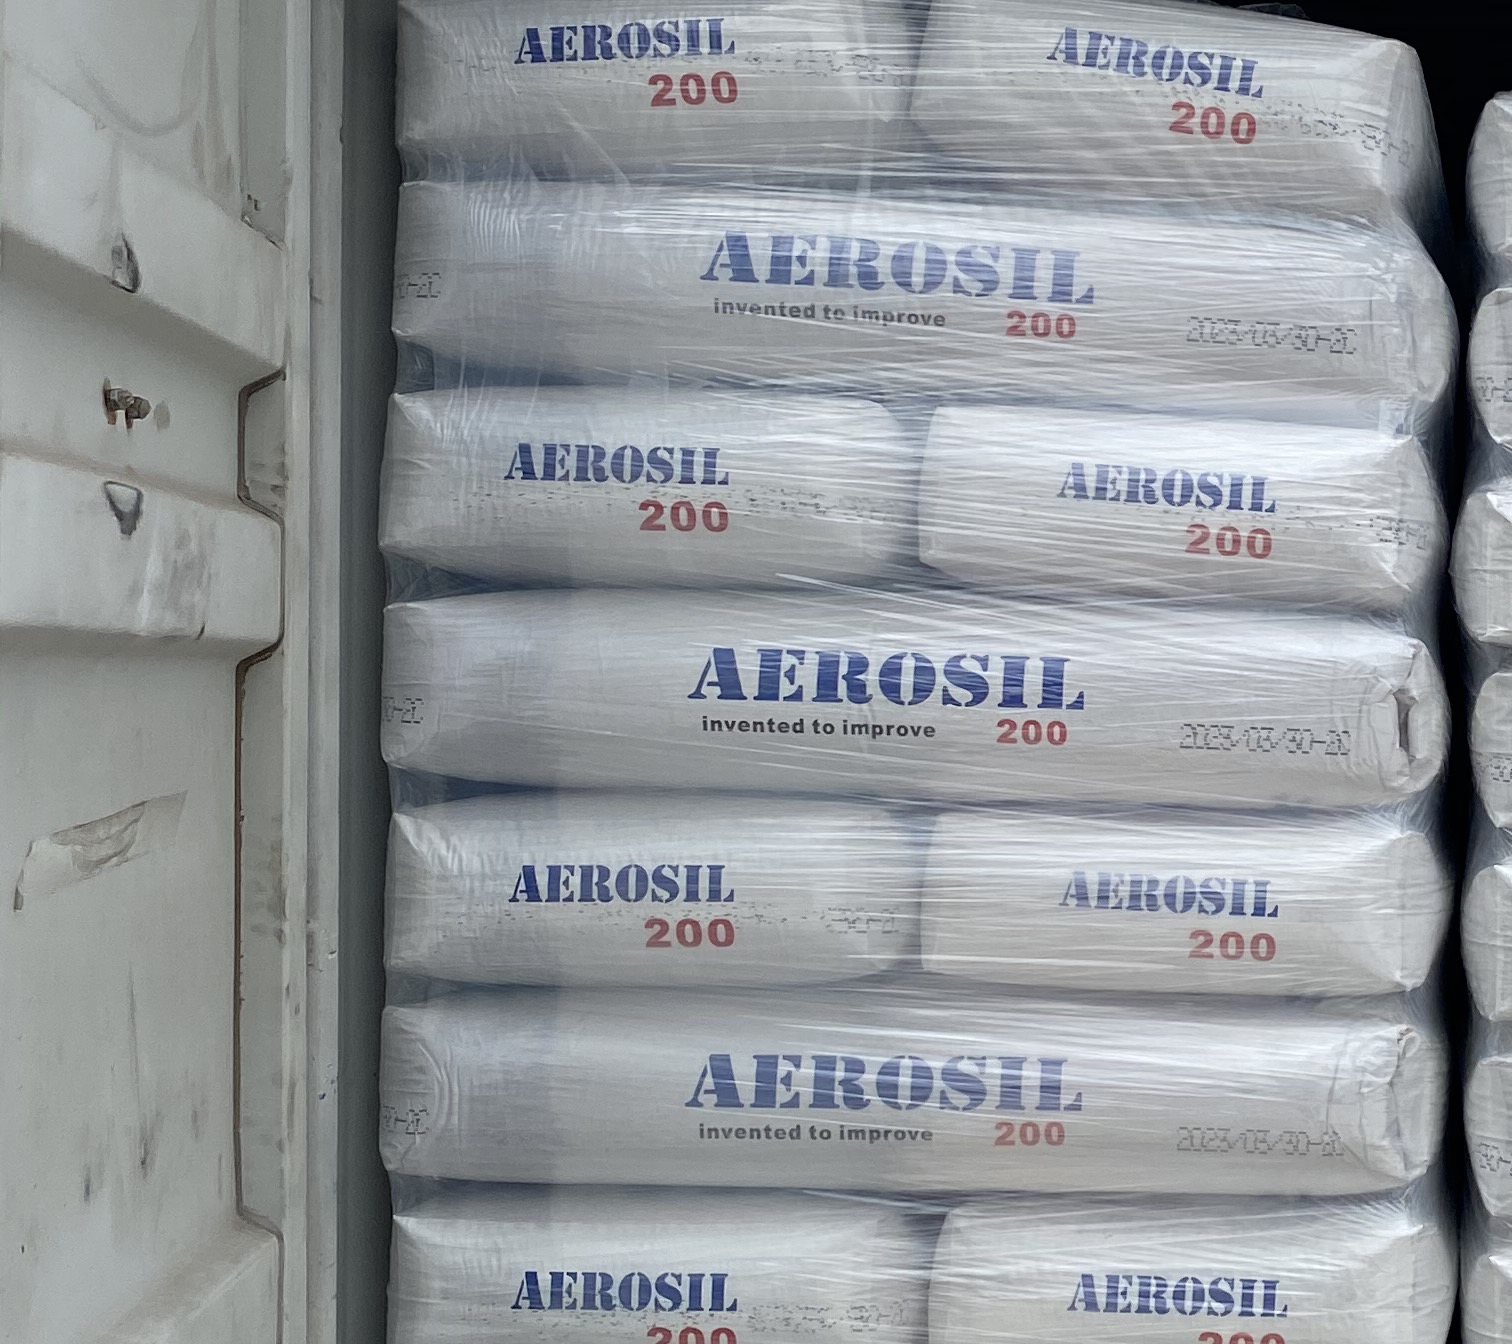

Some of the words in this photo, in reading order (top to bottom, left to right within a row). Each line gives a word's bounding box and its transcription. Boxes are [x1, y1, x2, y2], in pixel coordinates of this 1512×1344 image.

[514, 18, 736, 64] AEROSIL
[1047, 27, 1264, 97] AEROSIL
[648, 71, 738, 108] 200
[1169, 101, 1257, 144] 200
[700, 232, 1094, 303] AEROSIL
[714, 298, 815, 318] invented
[823, 305, 845, 319] to
[854, 306, 945, 326] improve
[1006, 309, 1077, 341] 200
[504, 442, 729, 484] AEROSIL
[1056, 463, 1276, 512] AEROSIL
[640, 500, 729, 533] 200
[1187, 523, 1273, 560] 200
[687, 647, 1085, 709] AEROSIL
[702, 716, 804, 734] invented
[812, 719, 835, 734] to
[843, 720, 936, 739] improve
[997, 718, 1069, 746] 200
[509, 864, 734, 902] AEROSIL
[1059, 872, 1279, 918] AEROSIL
[645, 917, 736, 948] 200
[1189, 929, 1277, 961] 200
[684, 1053, 1083, 1109] AEROSIL
[699, 1124, 800, 1140] invented
[809, 1126, 831, 1140] to
[840, 1126, 933, 1143] improve
[993, 1120, 1065, 1149] 200
[511, 1270, 737, 1311] AEROSIL
[1067, 1273, 1288, 1317] AEROSIL
